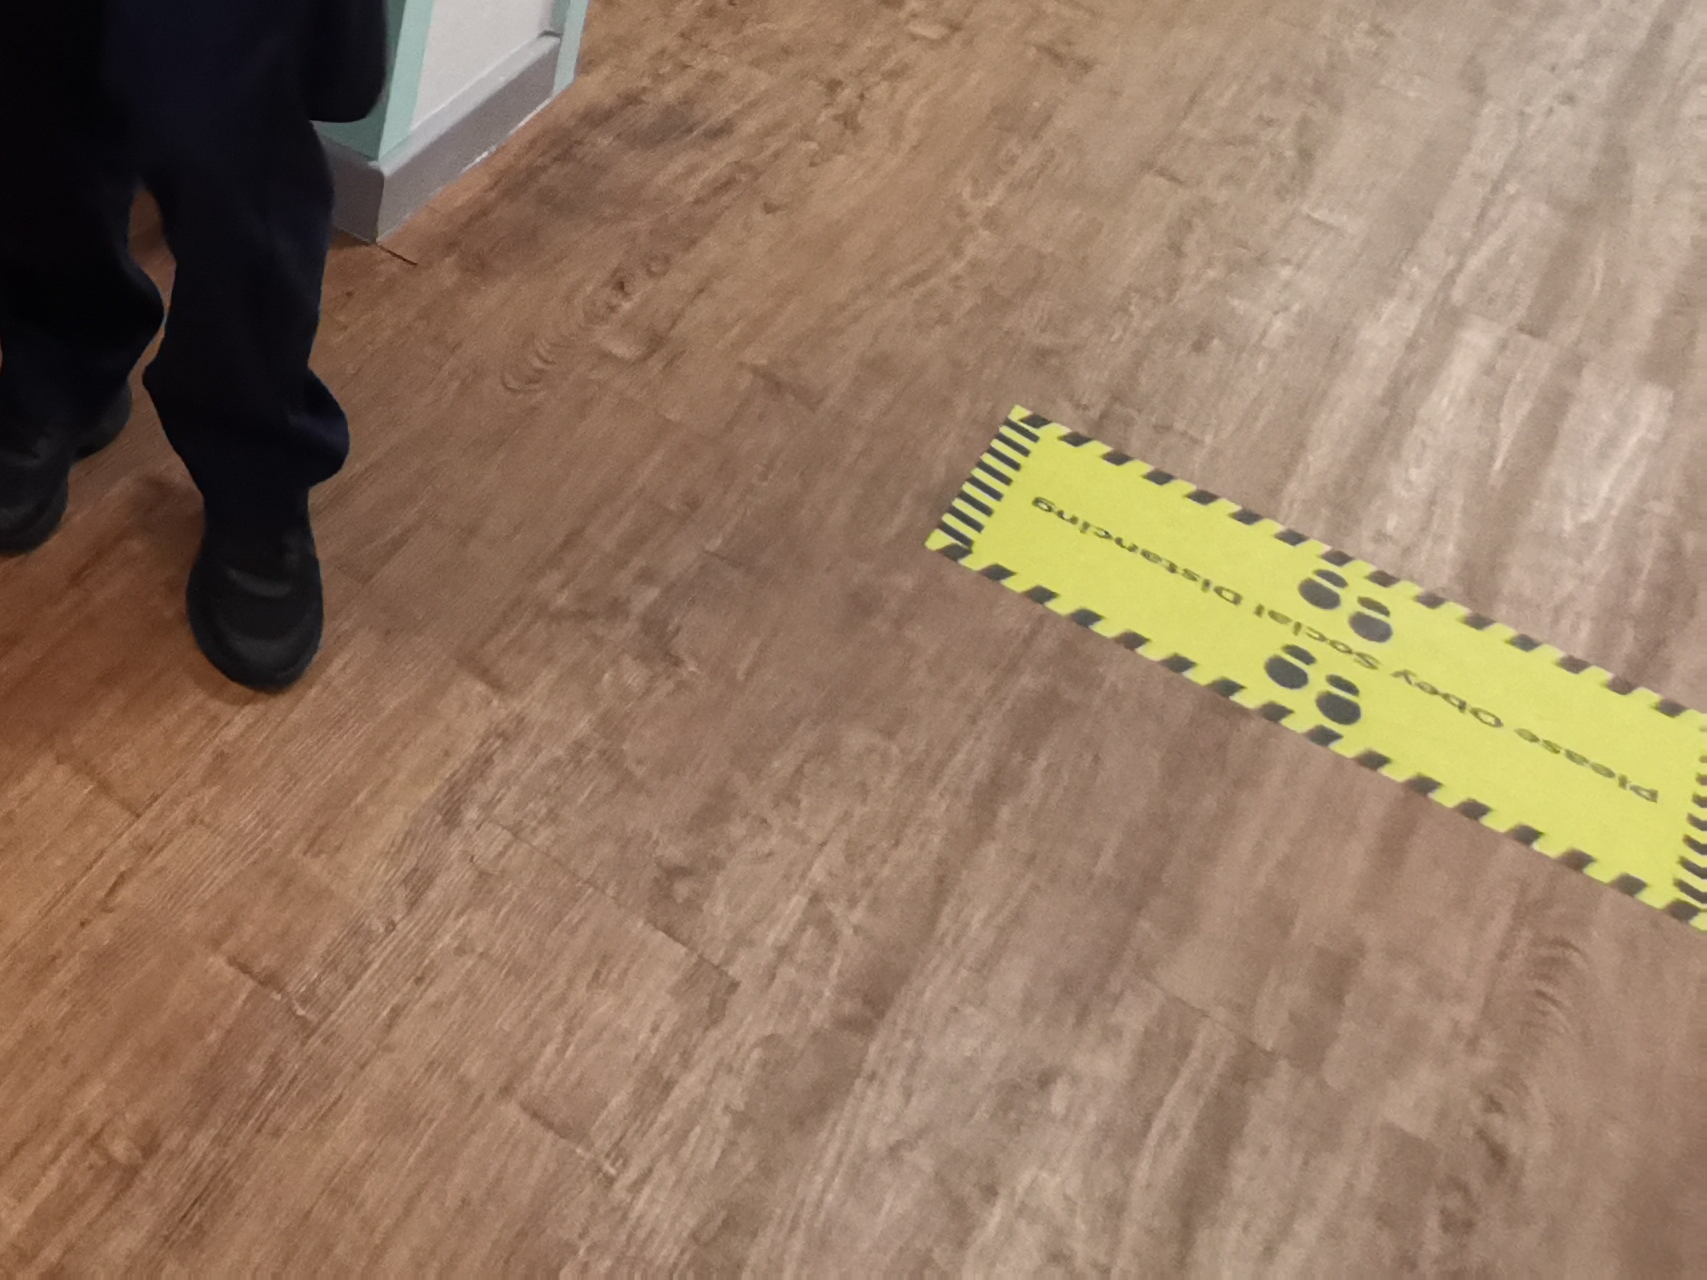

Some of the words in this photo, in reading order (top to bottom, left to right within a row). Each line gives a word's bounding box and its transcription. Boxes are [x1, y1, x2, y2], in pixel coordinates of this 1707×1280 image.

[1032, 496, 1243, 606] Distancing
[1253, 603, 1381, 670] Social
[1390, 669, 1504, 729] Obey
[1514, 727, 1659, 804] Please
